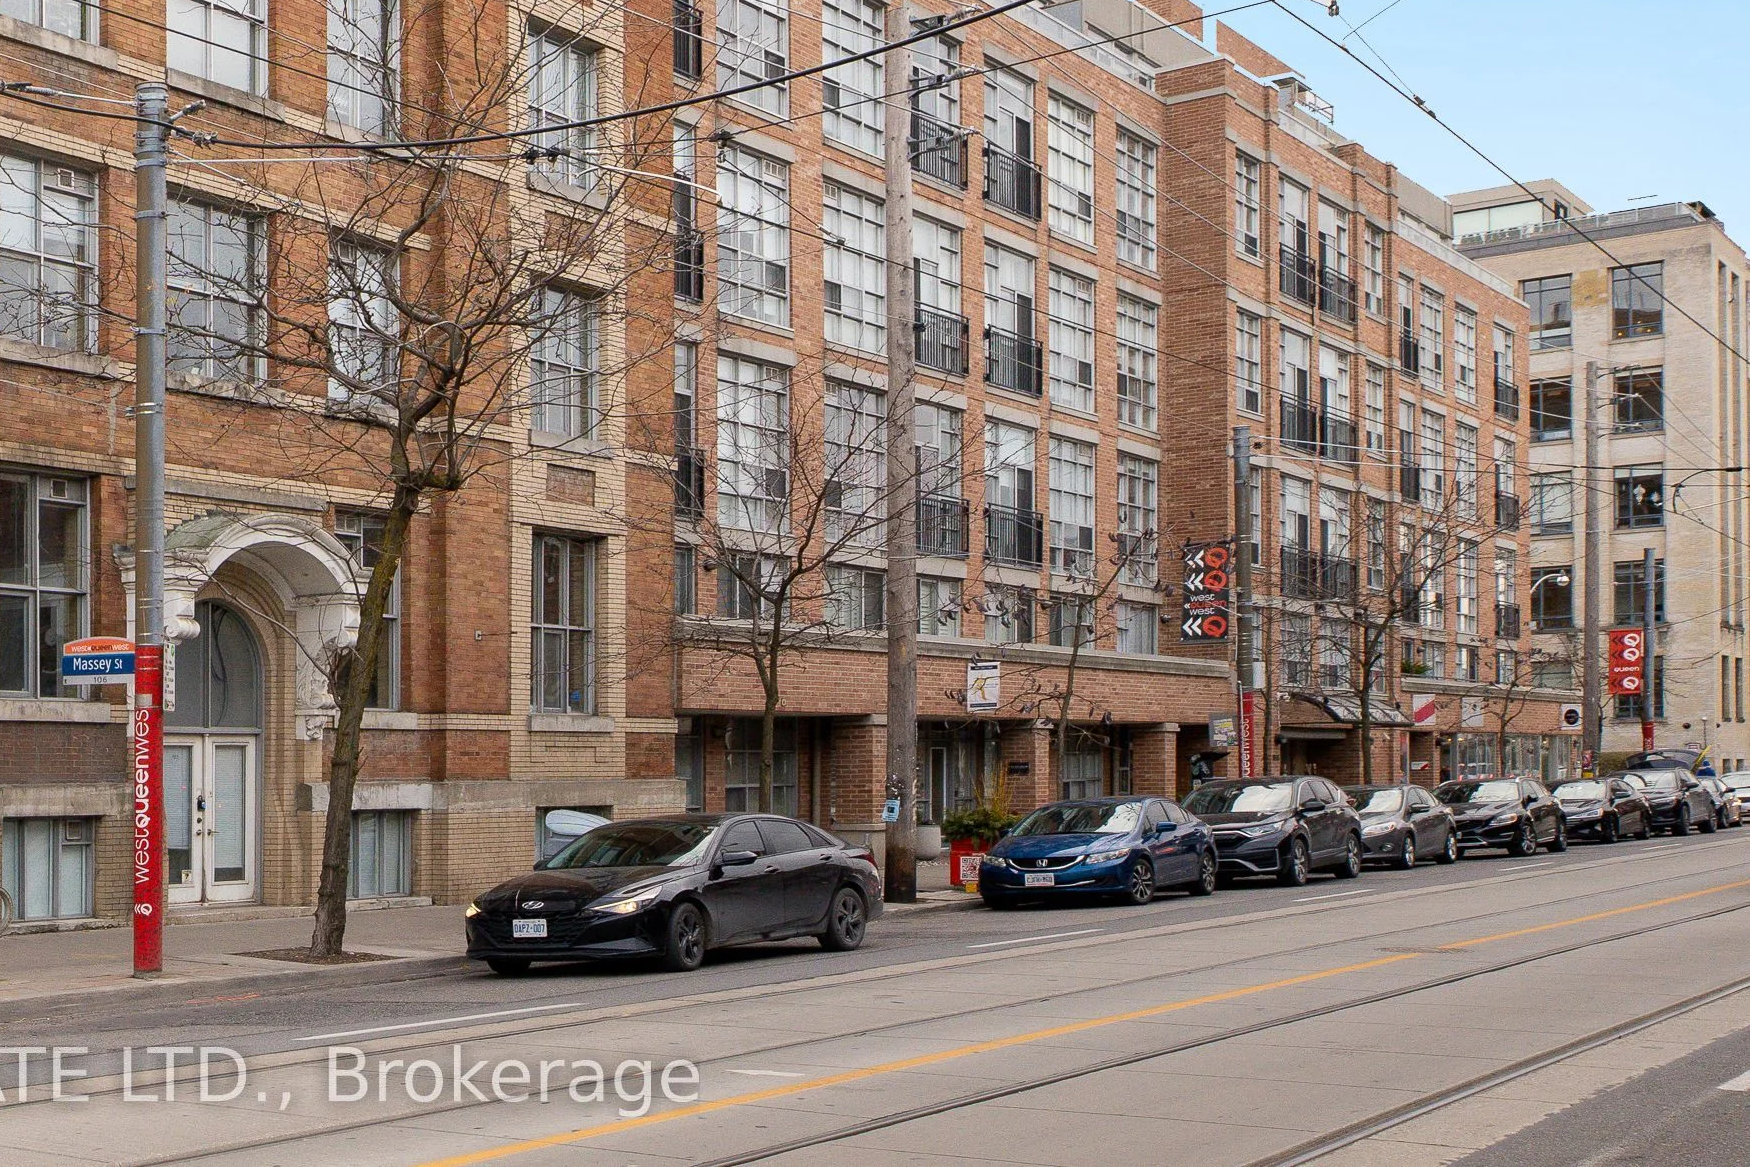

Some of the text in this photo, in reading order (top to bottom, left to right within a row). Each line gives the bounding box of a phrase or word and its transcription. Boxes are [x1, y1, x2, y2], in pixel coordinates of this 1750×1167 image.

[1190, 594, 1215, 602] west
[1190, 607, 1215, 615] west
[73, 657, 123, 673] Massey St
[93, 676, 108, 684] 106
